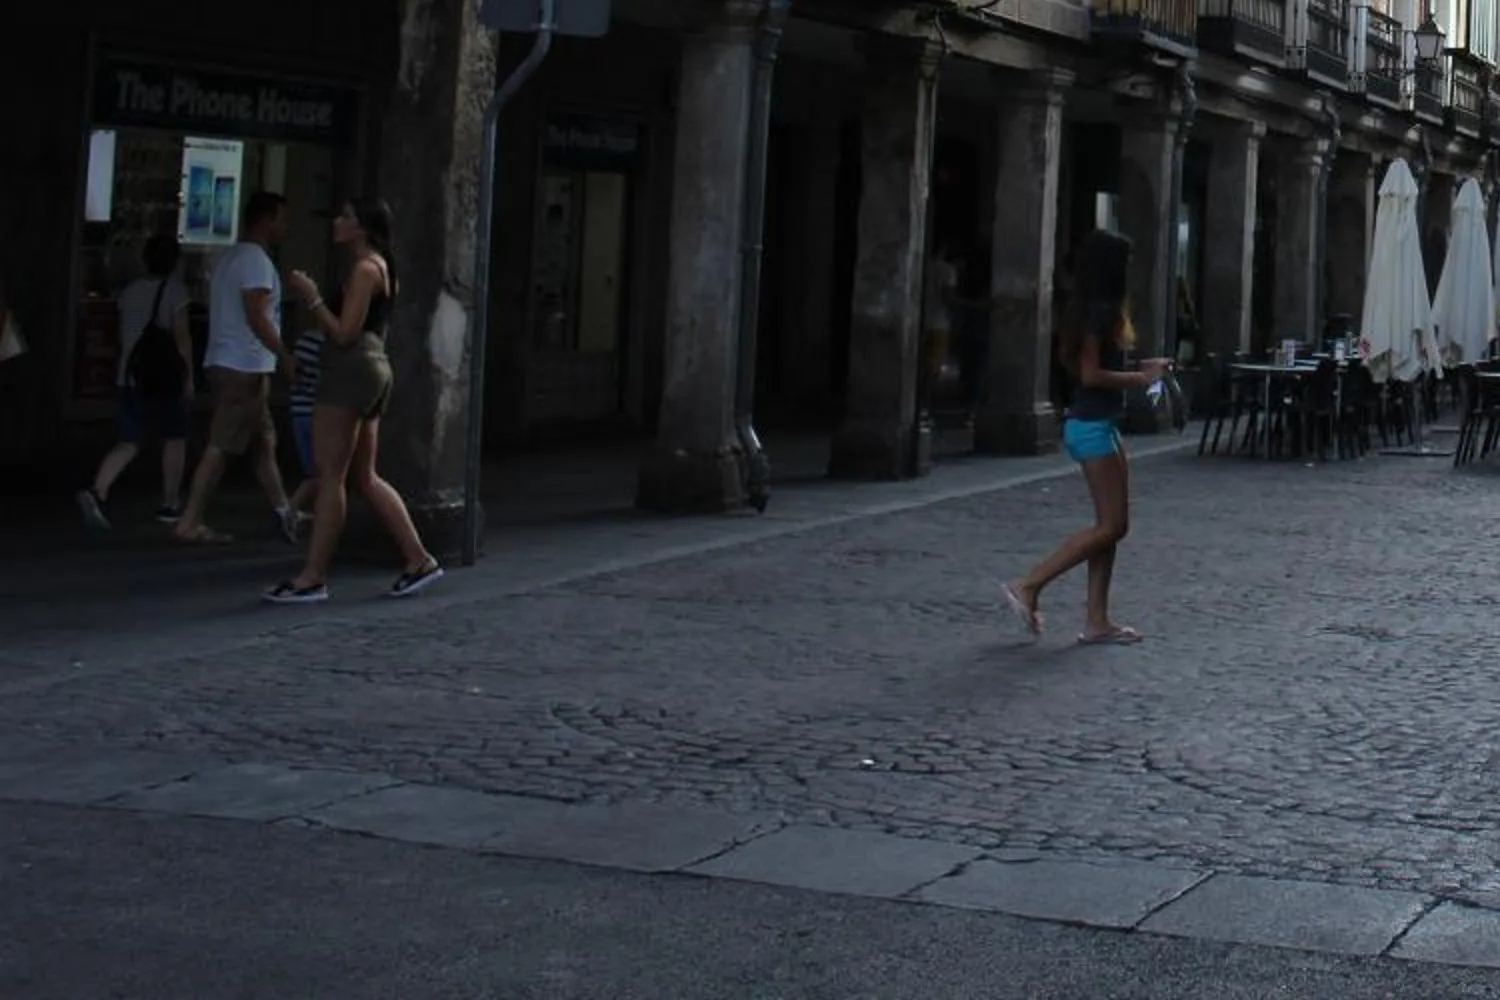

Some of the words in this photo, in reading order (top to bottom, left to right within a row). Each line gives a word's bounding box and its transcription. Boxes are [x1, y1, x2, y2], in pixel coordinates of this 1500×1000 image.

[115, 70, 165, 113] The
[168, 74, 254, 121] Phone
[257, 86, 335, 127] House
